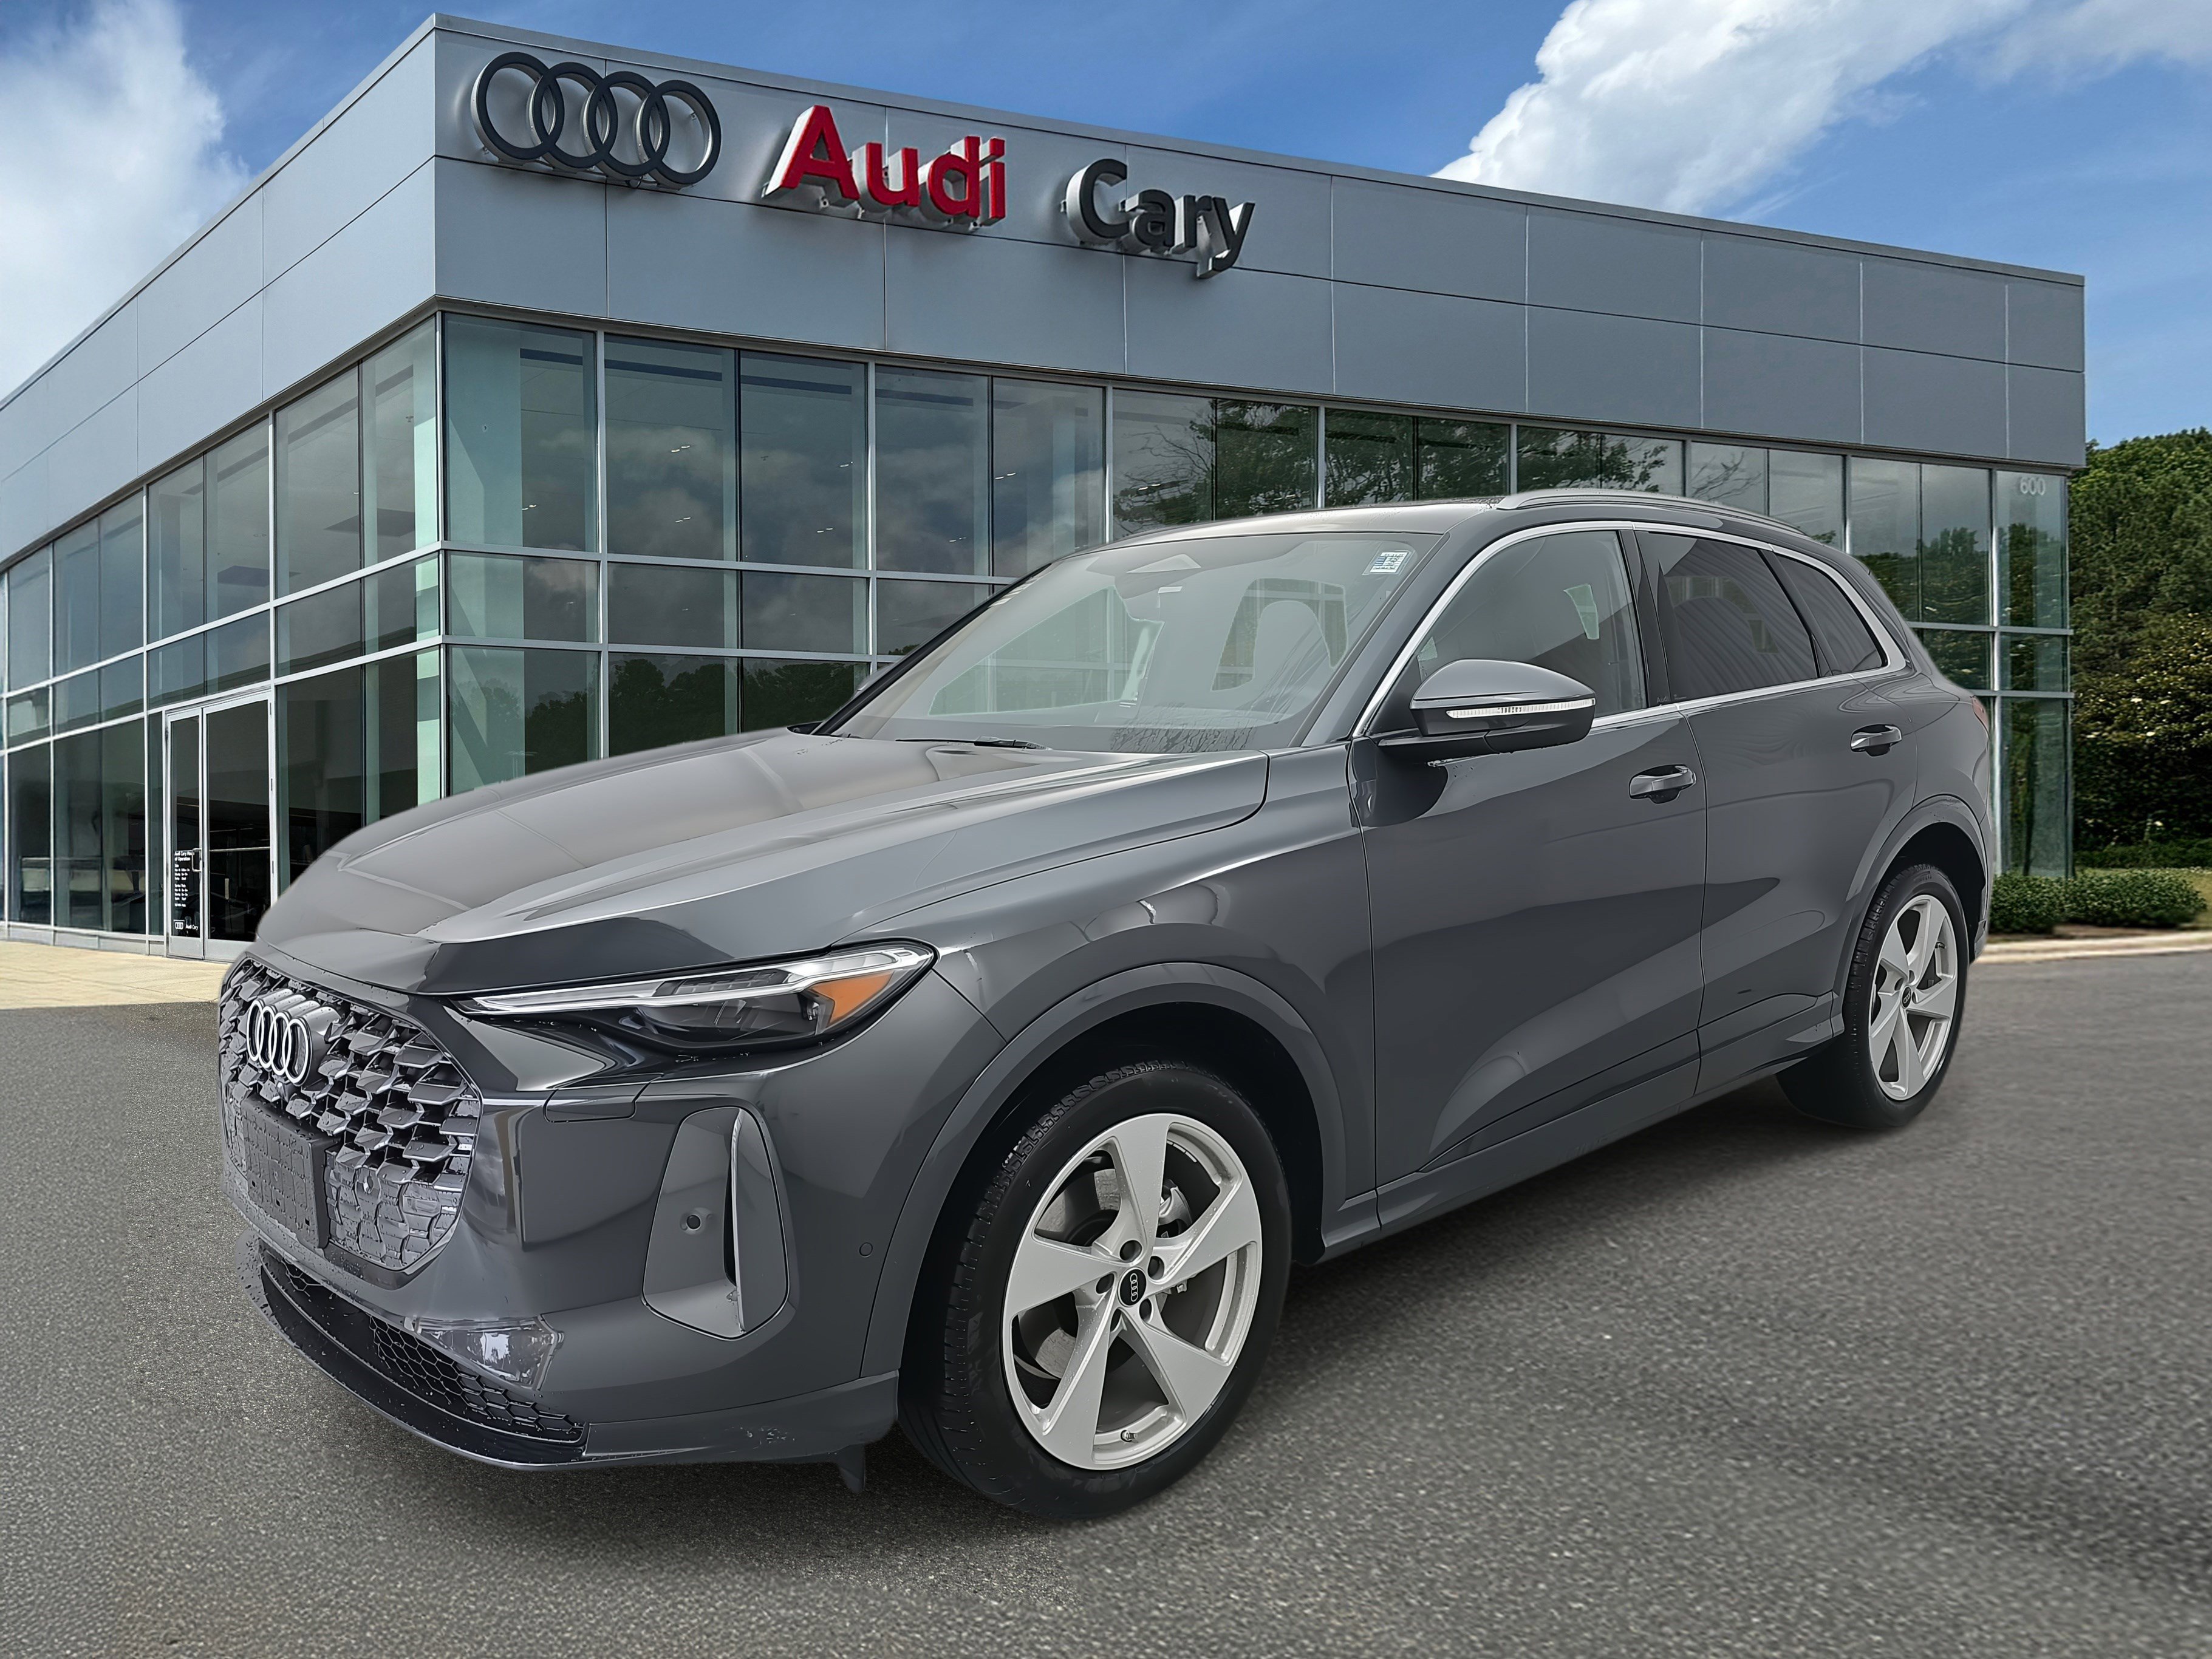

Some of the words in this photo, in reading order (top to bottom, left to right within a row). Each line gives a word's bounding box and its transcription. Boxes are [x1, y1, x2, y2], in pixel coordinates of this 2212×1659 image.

[768, 105, 1006, 226] Audi
[1067, 158, 1255, 277] Cary
[2020, 477, 2046, 496] 600
